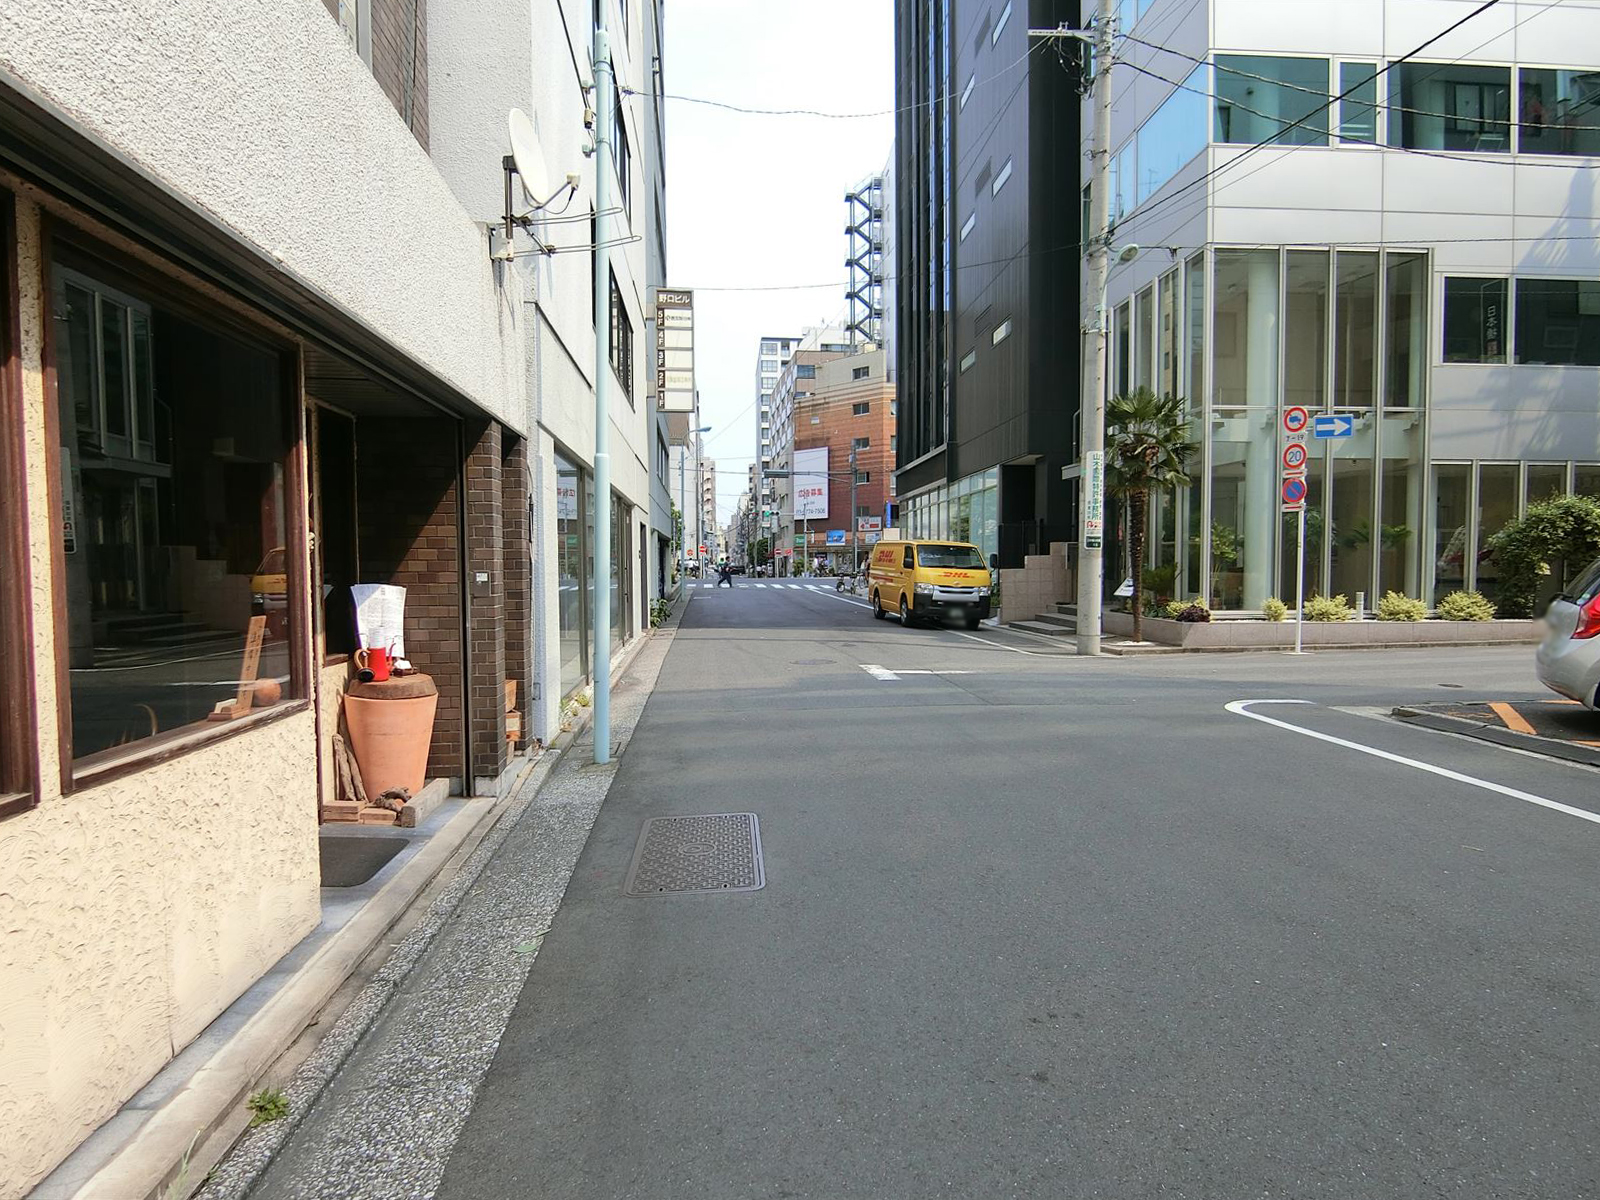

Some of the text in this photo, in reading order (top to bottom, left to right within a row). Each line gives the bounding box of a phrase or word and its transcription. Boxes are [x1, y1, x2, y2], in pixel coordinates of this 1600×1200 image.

[658, 293, 691, 304] 野口ビル
[1288, 450, 1302, 463] 20
